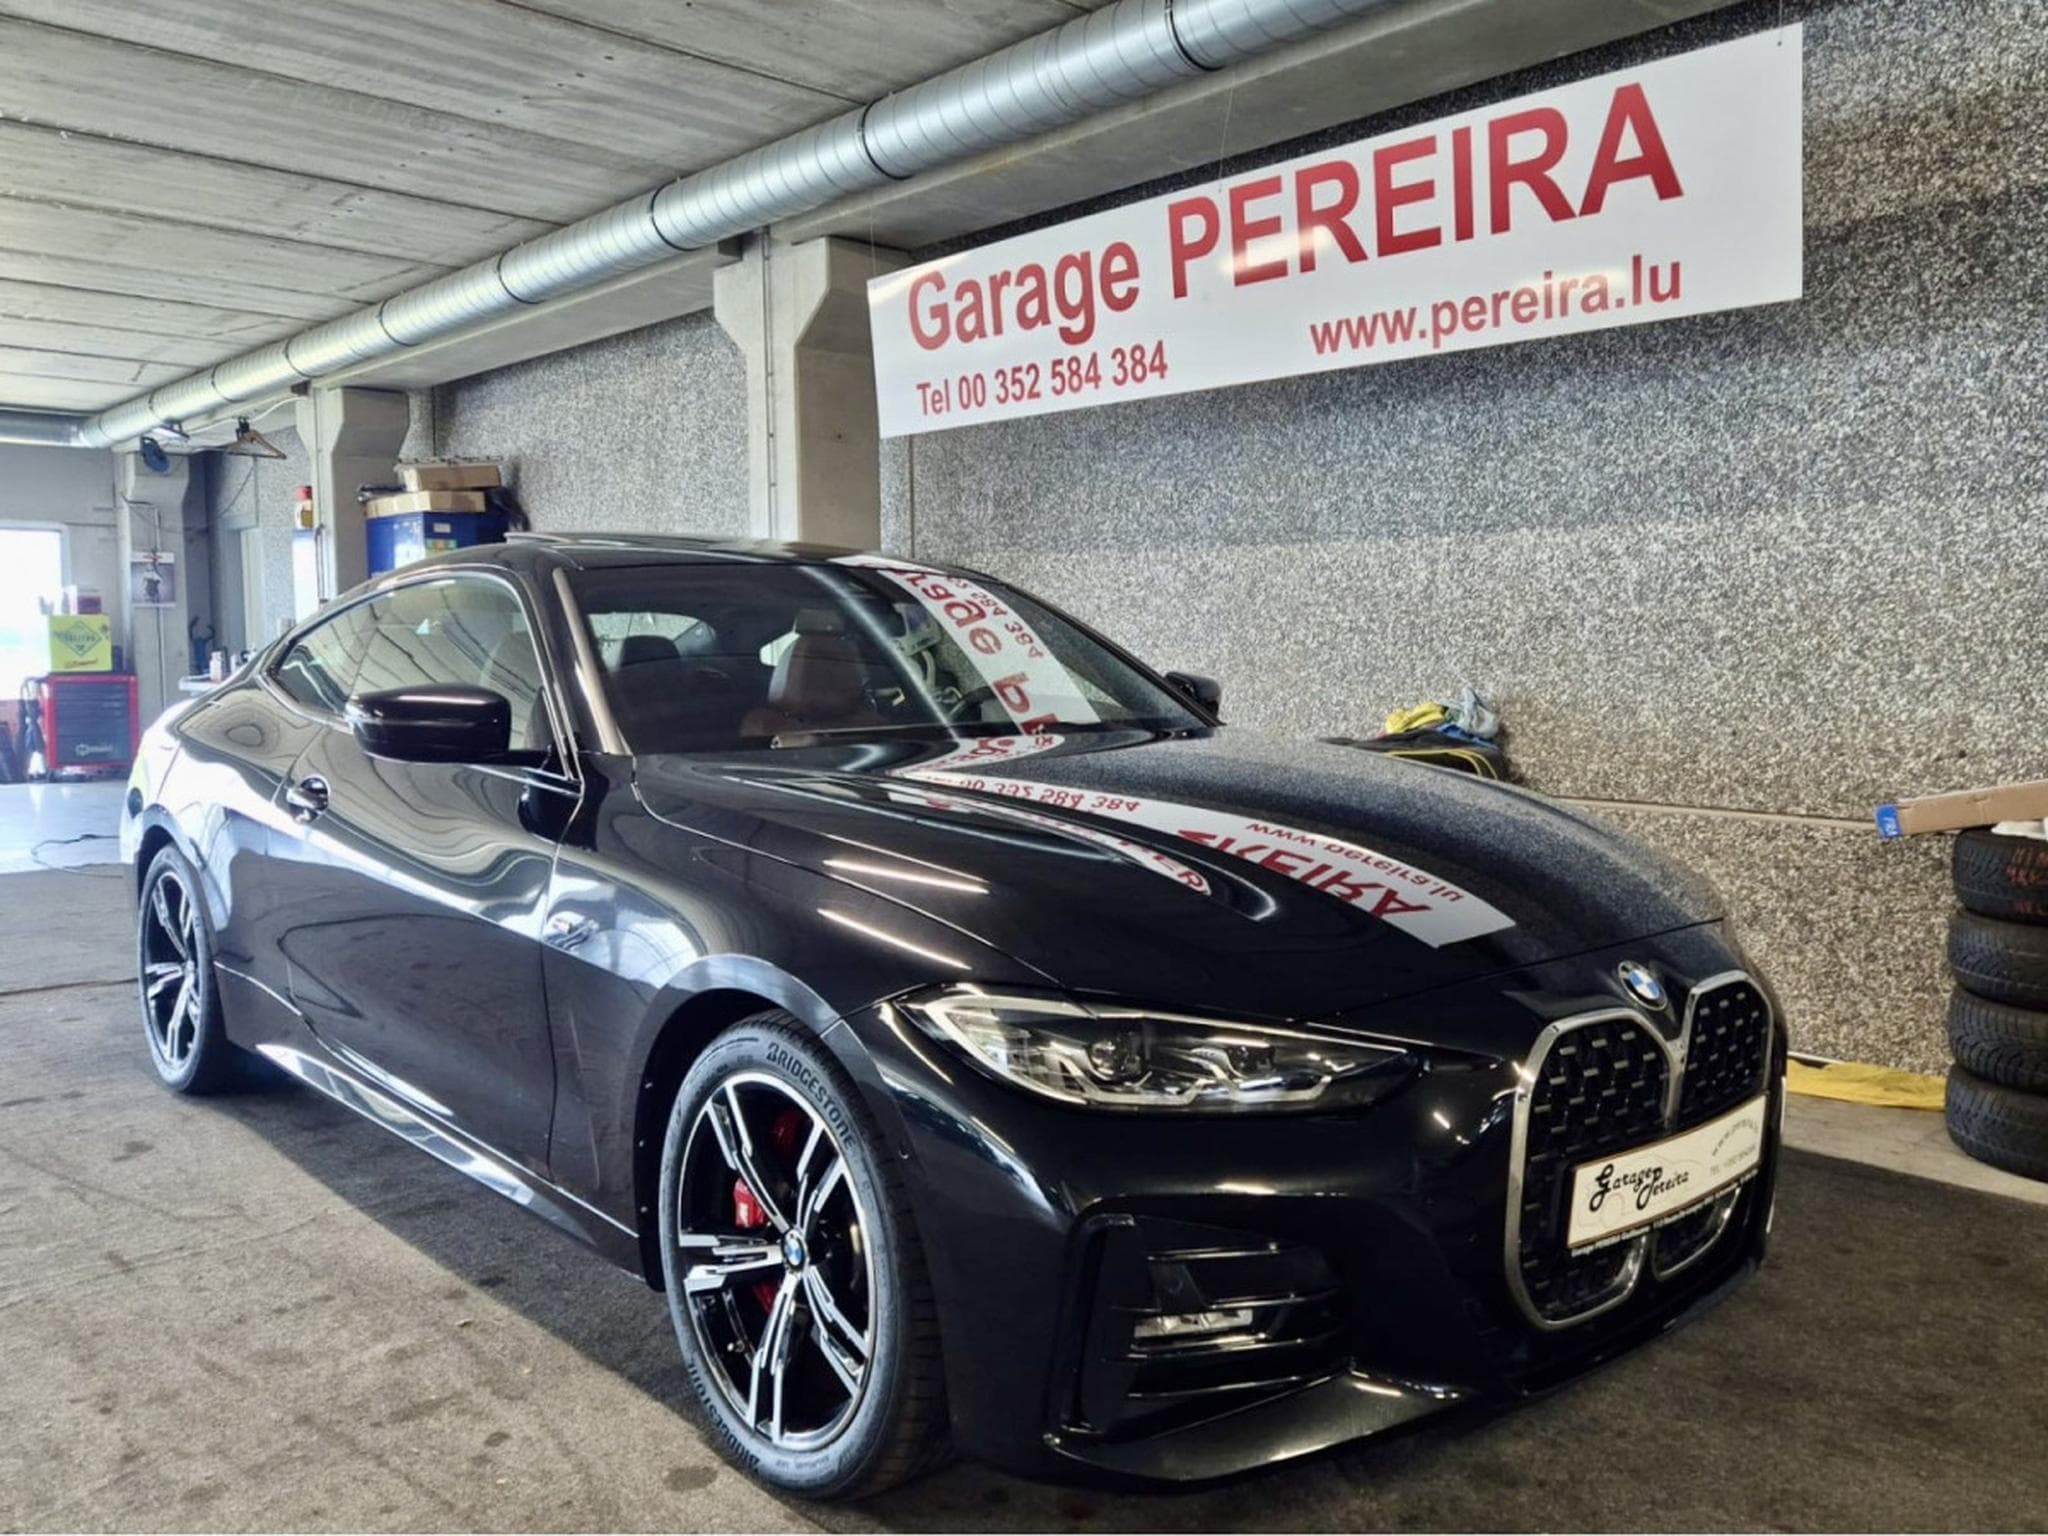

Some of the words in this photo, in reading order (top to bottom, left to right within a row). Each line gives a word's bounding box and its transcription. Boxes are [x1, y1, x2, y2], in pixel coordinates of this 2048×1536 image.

[908, 238, 1140, 351] Garage
[1168, 82, 1684, 299] PEREIRA
[1309, 254, 1682, 354] www.pereira.lu
[916, 378, 950, 416] Tel
[958, 373, 986, 410] 00
[994, 362, 1041, 405] 352
[1051, 351, 1102, 396] 584
[1111, 339, 1169, 387] 384
[766, 1042, 857, 1150] BRIDGESTONE
[1588, 1163, 1652, 1213] Garage
[1635, 1166, 1690, 1210] Pereira
